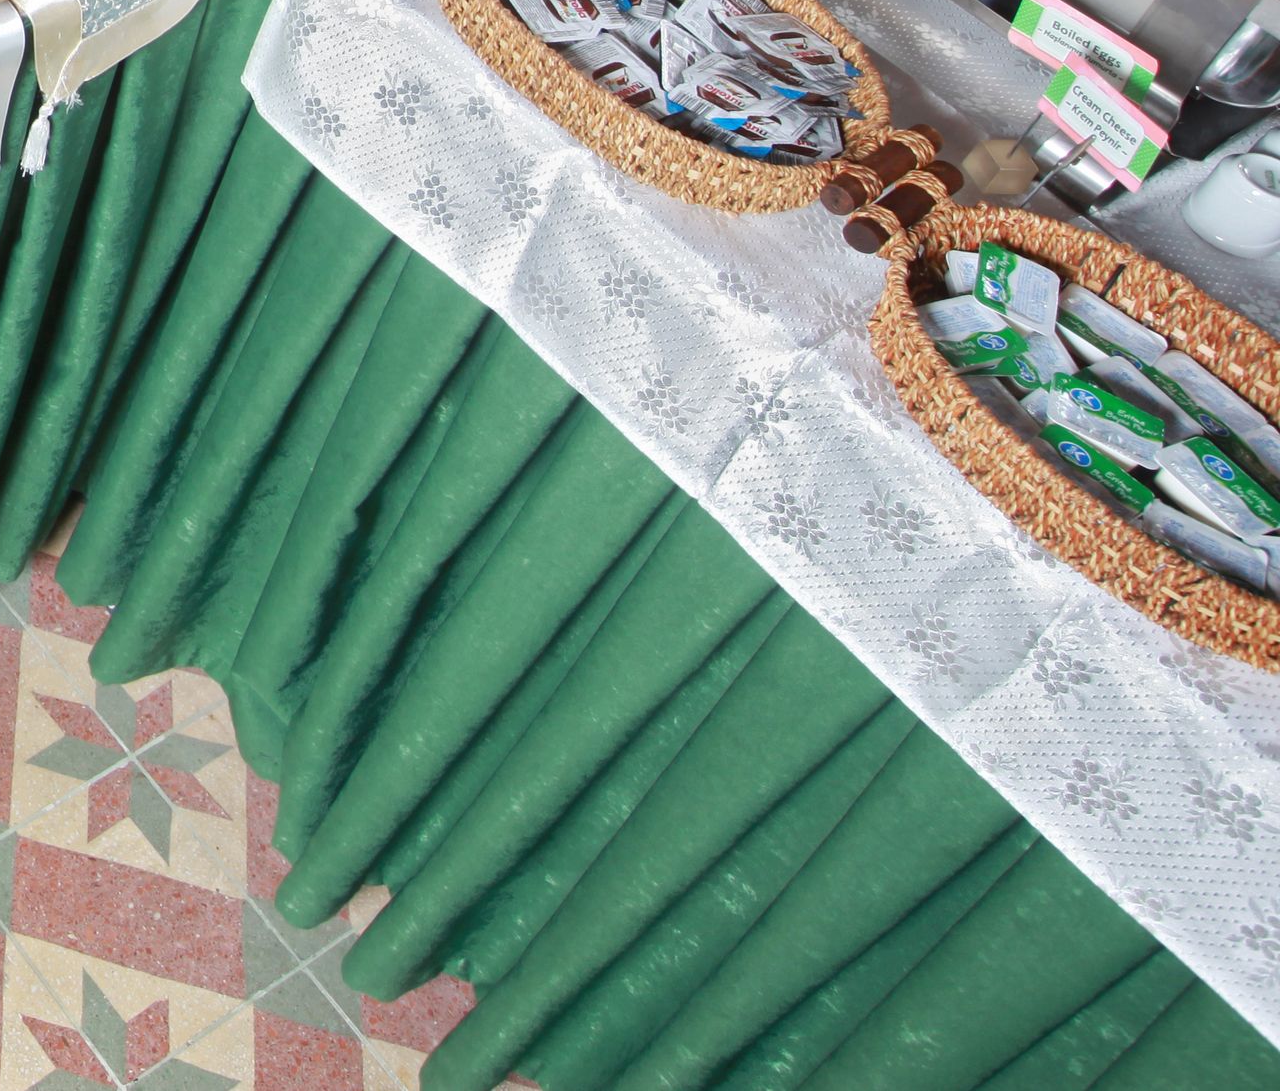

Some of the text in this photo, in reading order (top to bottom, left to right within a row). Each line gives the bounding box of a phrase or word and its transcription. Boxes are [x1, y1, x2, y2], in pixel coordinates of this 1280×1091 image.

[1052, 20, 1121, 69] Boiled Eggs
[1071, 105, 1122, 151] Krem Peynir
[1072, 85, 1138, 147] Cream Cheese
